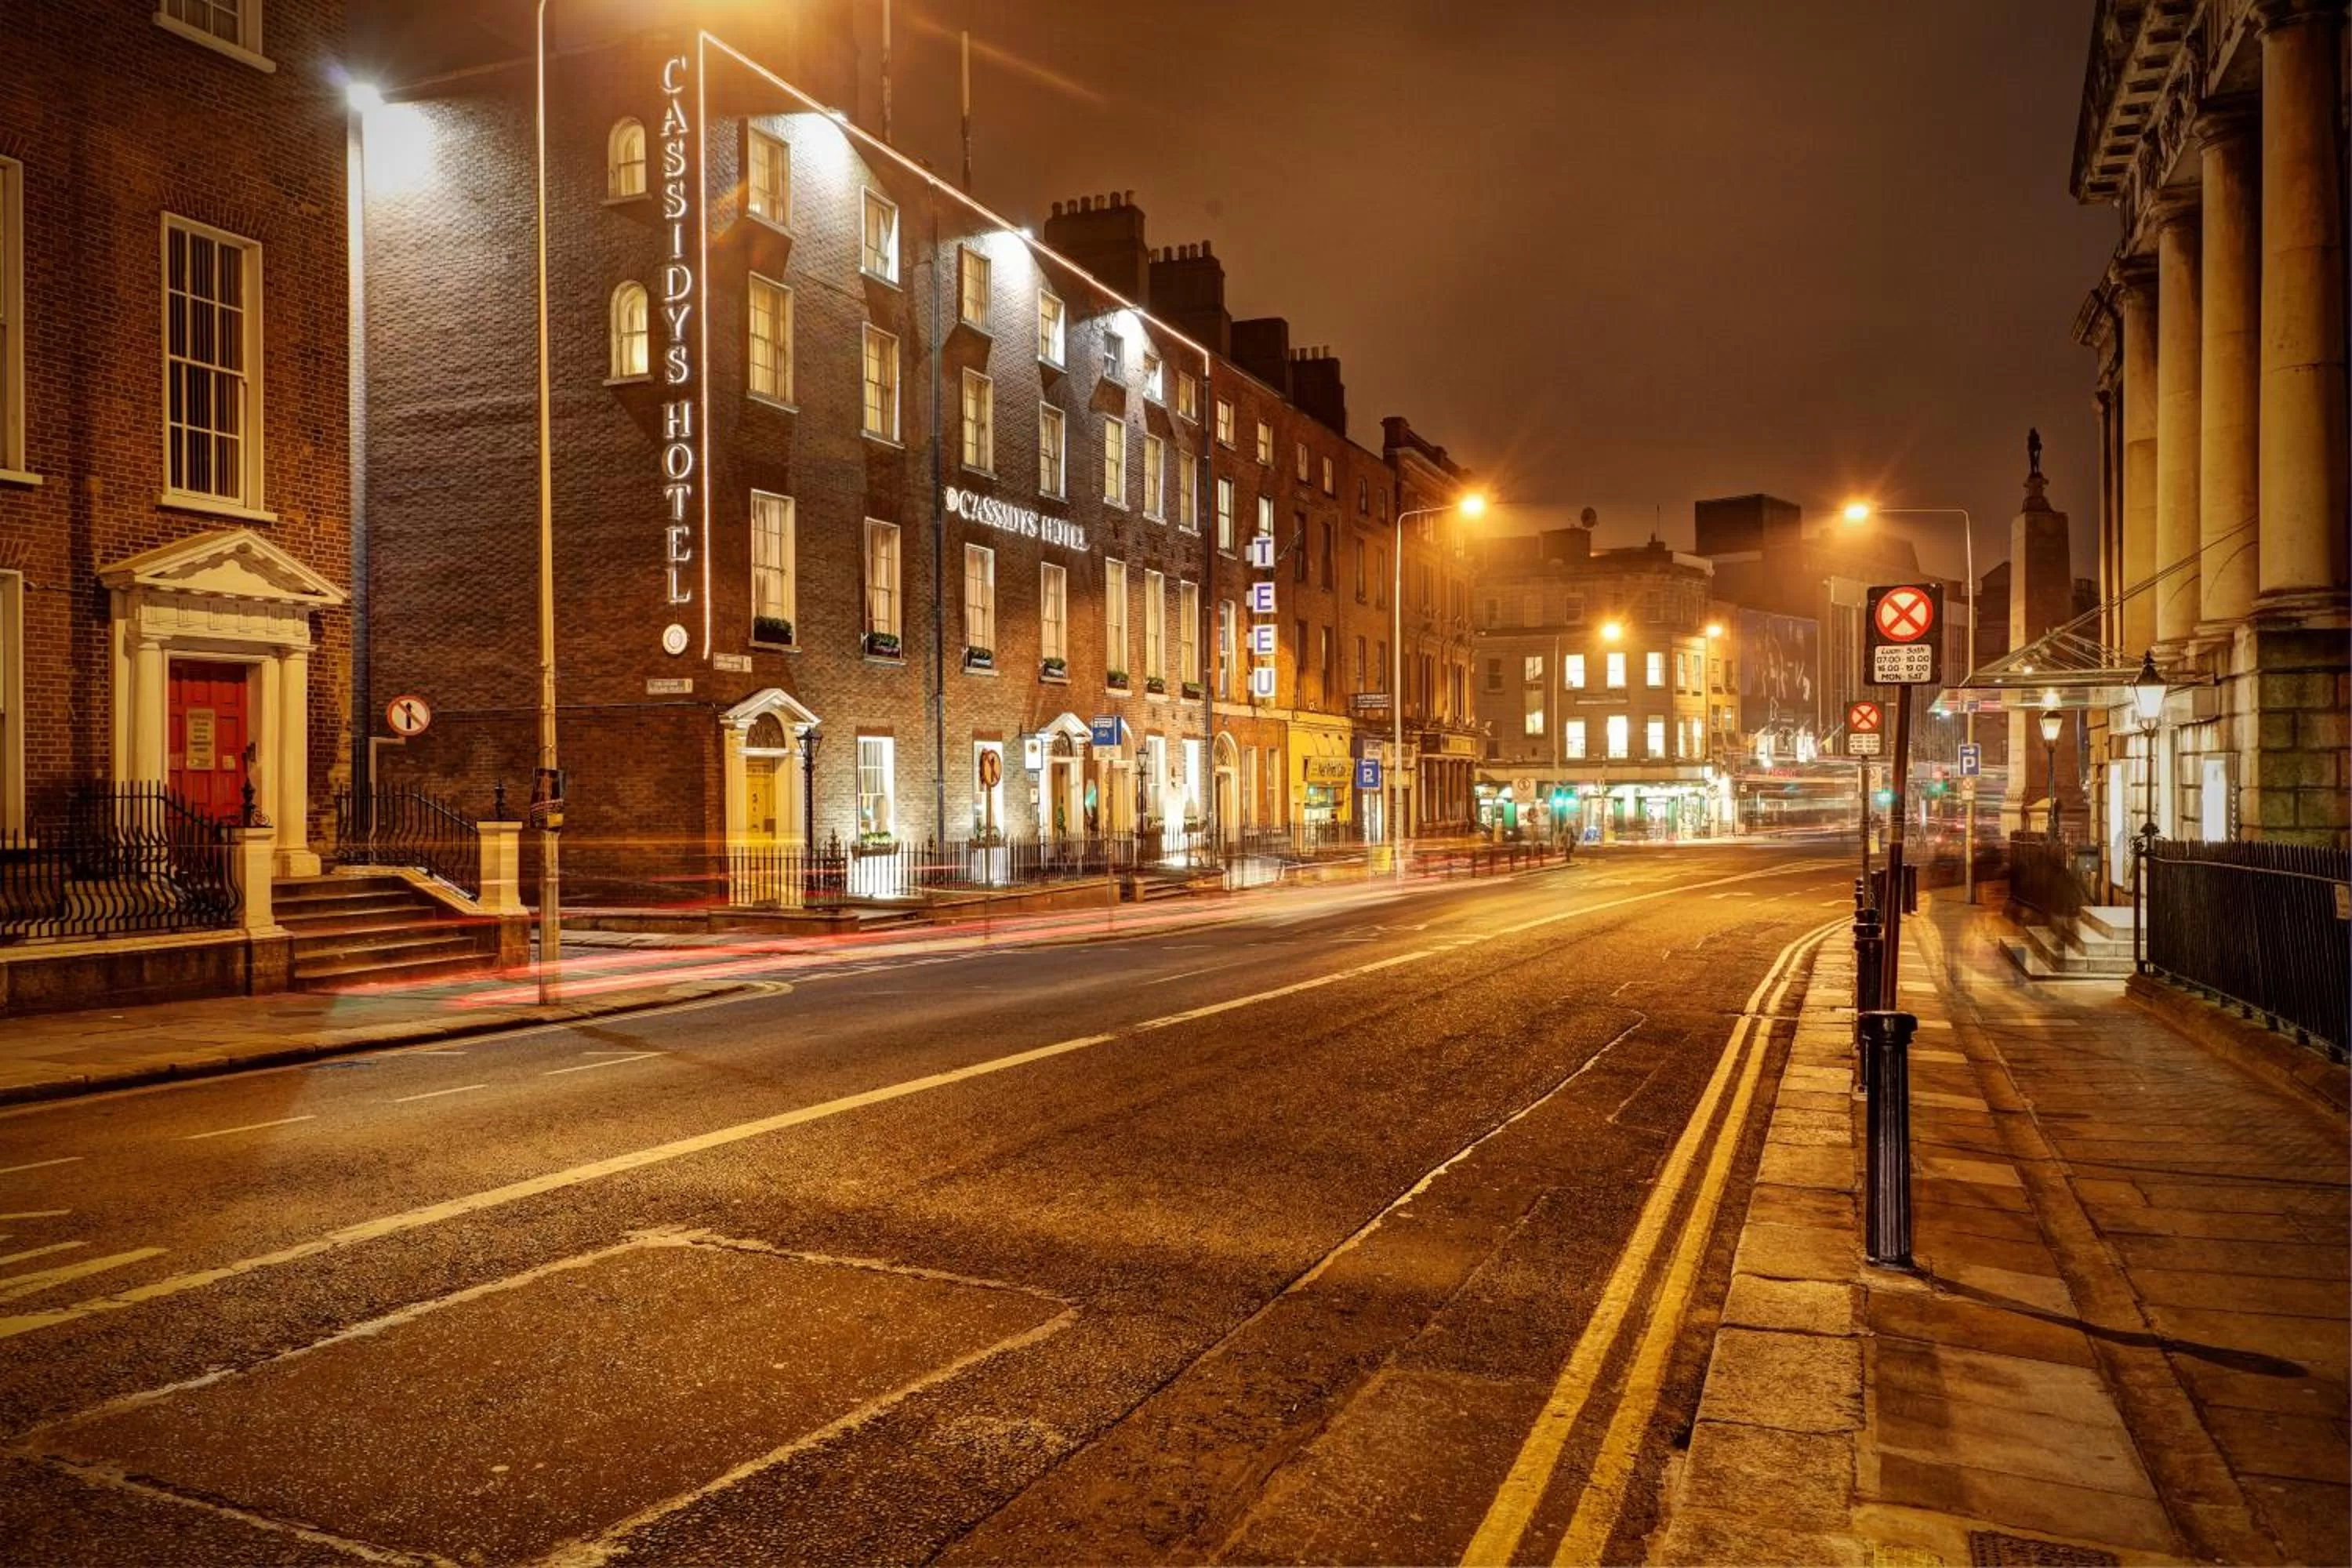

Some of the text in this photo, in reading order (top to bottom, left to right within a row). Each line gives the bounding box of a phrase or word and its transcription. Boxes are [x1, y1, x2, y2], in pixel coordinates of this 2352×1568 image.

[661, 55, 693, 604] CASSIDYS HOTEL
[1255, 539, 1272, 695] TEEU
[1962, 756, 1976, 774] P
